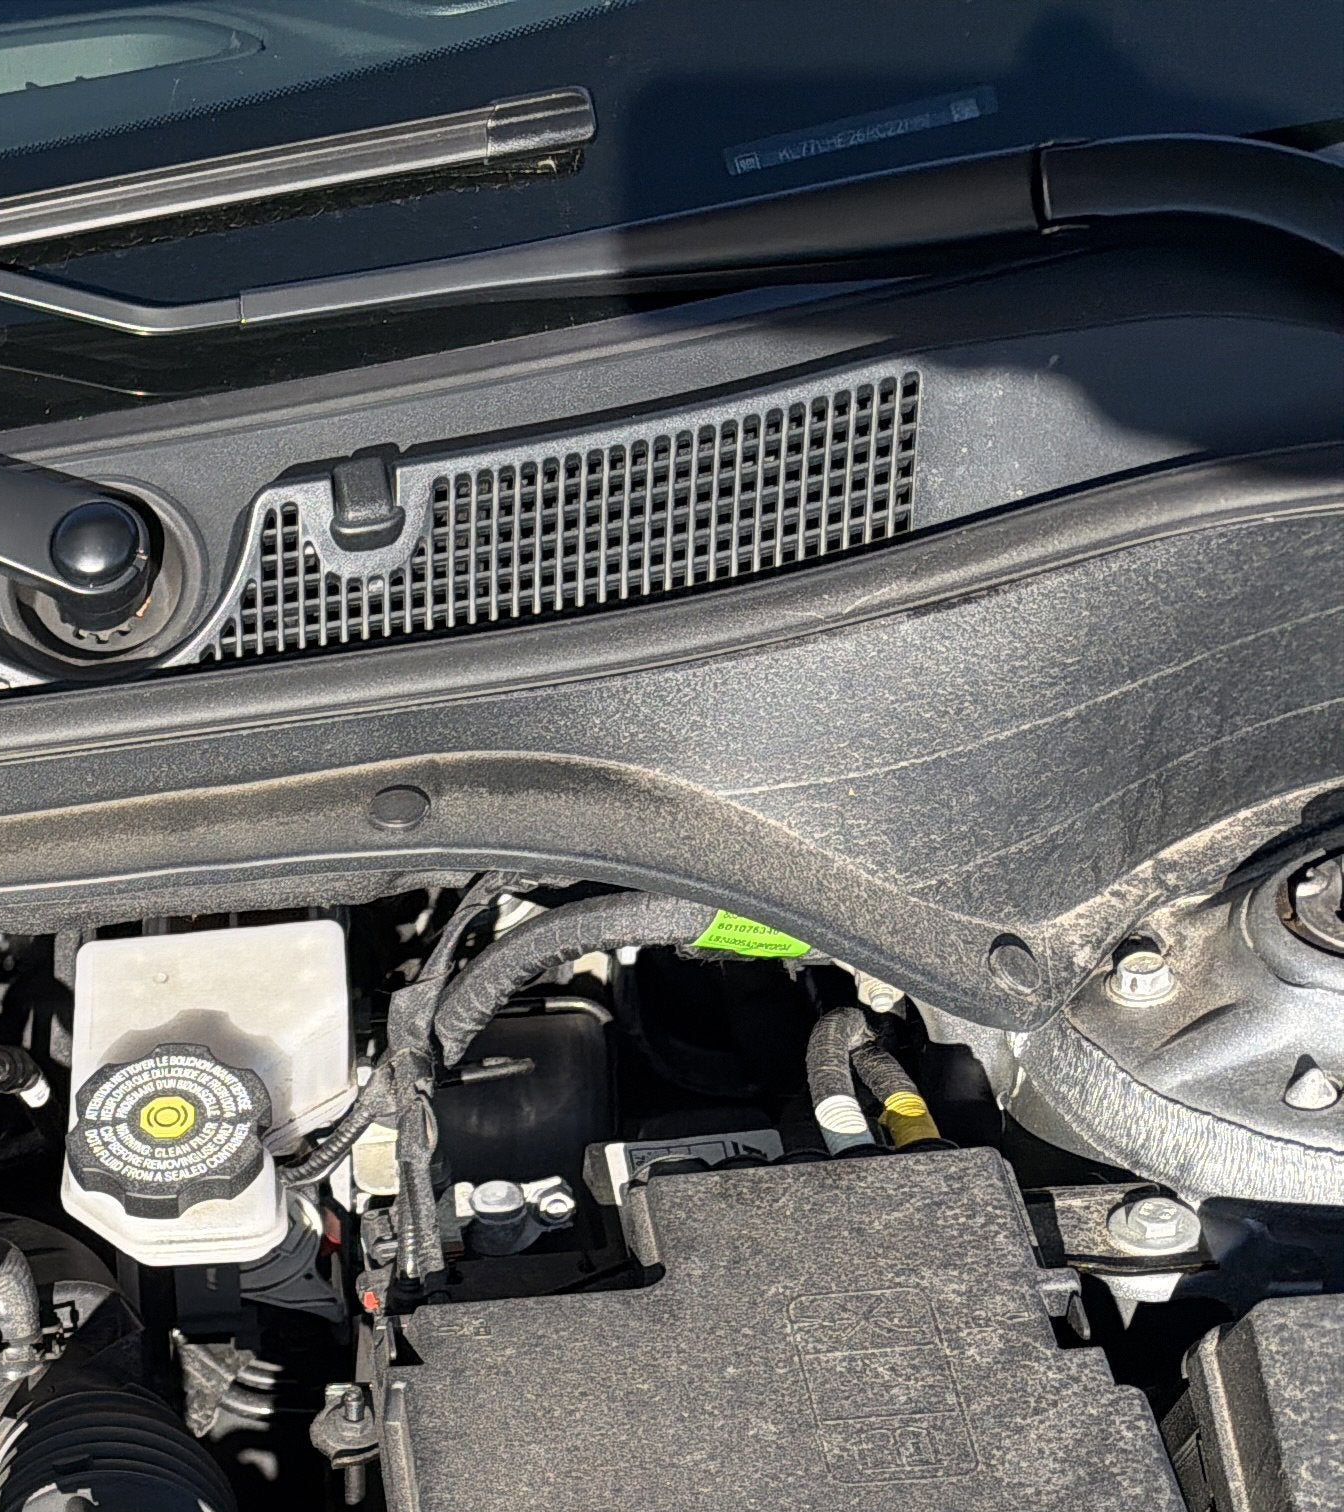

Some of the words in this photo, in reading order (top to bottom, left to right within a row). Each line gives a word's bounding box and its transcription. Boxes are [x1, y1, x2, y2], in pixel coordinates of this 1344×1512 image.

[109, 1058, 155, 1083] NETTOYER
[169, 1055, 212, 1073] BOUCHON
[131, 1070, 152, 1085] QUE
[164, 1066, 200, 1080] LIQUIDE
[206, 1078, 231, 1099] FREIN
[176, 1078, 204, 1095] BIDON
[95, 1149, 124, 1171] FLUID
[120, 1164, 154, 1181] FROM
[163, 1162, 210, 1181] SEALED
[205, 1122, 250, 1169] CONTAINER.
[99, 1125, 117, 1142] CAP
[108, 1140, 144, 1167] BEFORE
[195, 1141, 220, 1159] USE
[212, 1121, 233, 1144] ONLY
[115, 1122, 152, 1157] WARNING:
[154, 1143, 193, 1158] CLEAN
[189, 1121, 218, 1149] FILLER
